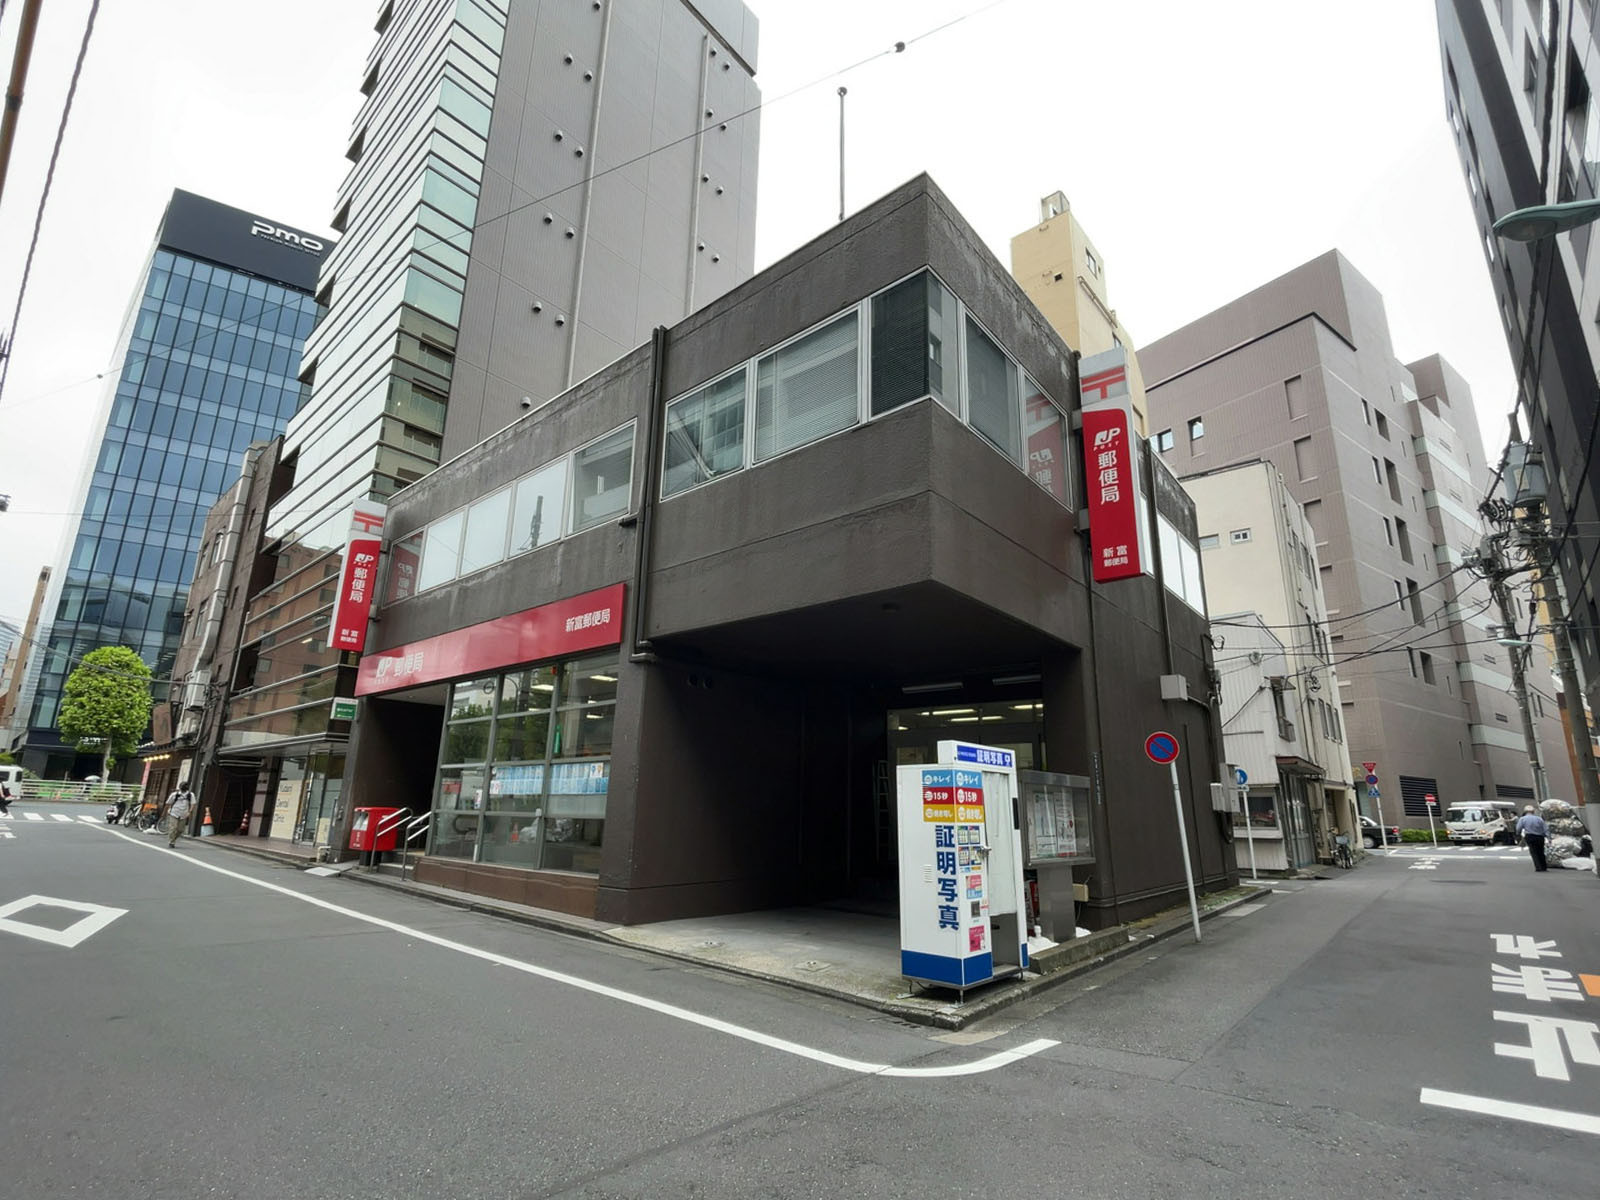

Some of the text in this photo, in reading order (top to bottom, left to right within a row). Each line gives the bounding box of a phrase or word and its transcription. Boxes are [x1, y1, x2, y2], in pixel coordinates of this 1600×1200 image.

[251, 220, 324, 251] pmo
[1098, 450, 1121, 506] 郵便局
[1103, 544, 1128, 557] 新富
[1104, 556, 1129, 568] 郵便局
[349, 566, 368, 604] 郵便局
[565, 608, 611, 633] 新富郵便局
[393, 651, 425, 677] 郵便局
[933, 775, 951, 784] キレイ
[964, 773, 980, 785] キレイ
[935, 825, 959, 931] 証明写真
